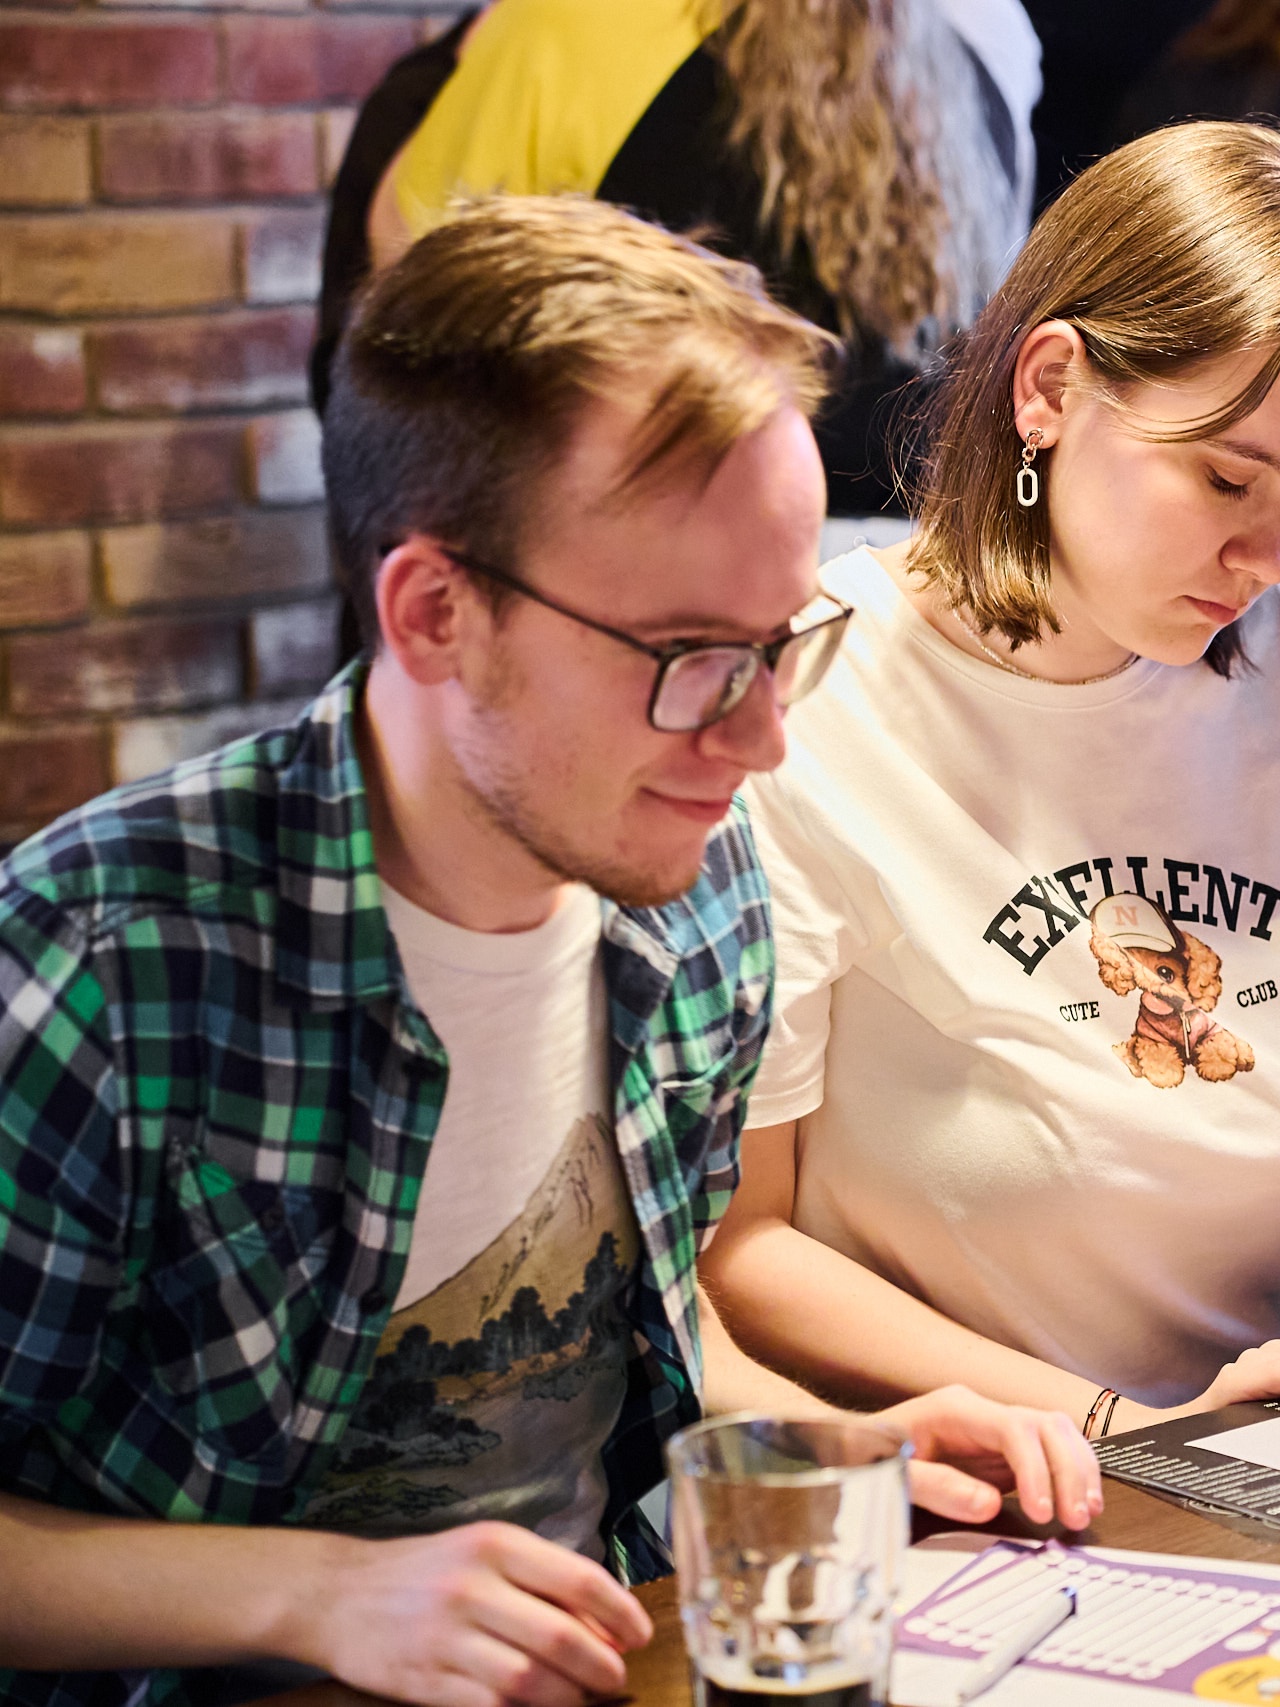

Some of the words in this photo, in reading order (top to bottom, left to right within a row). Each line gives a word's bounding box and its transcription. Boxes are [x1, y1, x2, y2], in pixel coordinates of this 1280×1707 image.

[1112, 905, 1139, 926] N
[1058, 1001, 1101, 1022] CUTE
[1236, 979, 1279, 1009] CLUB
